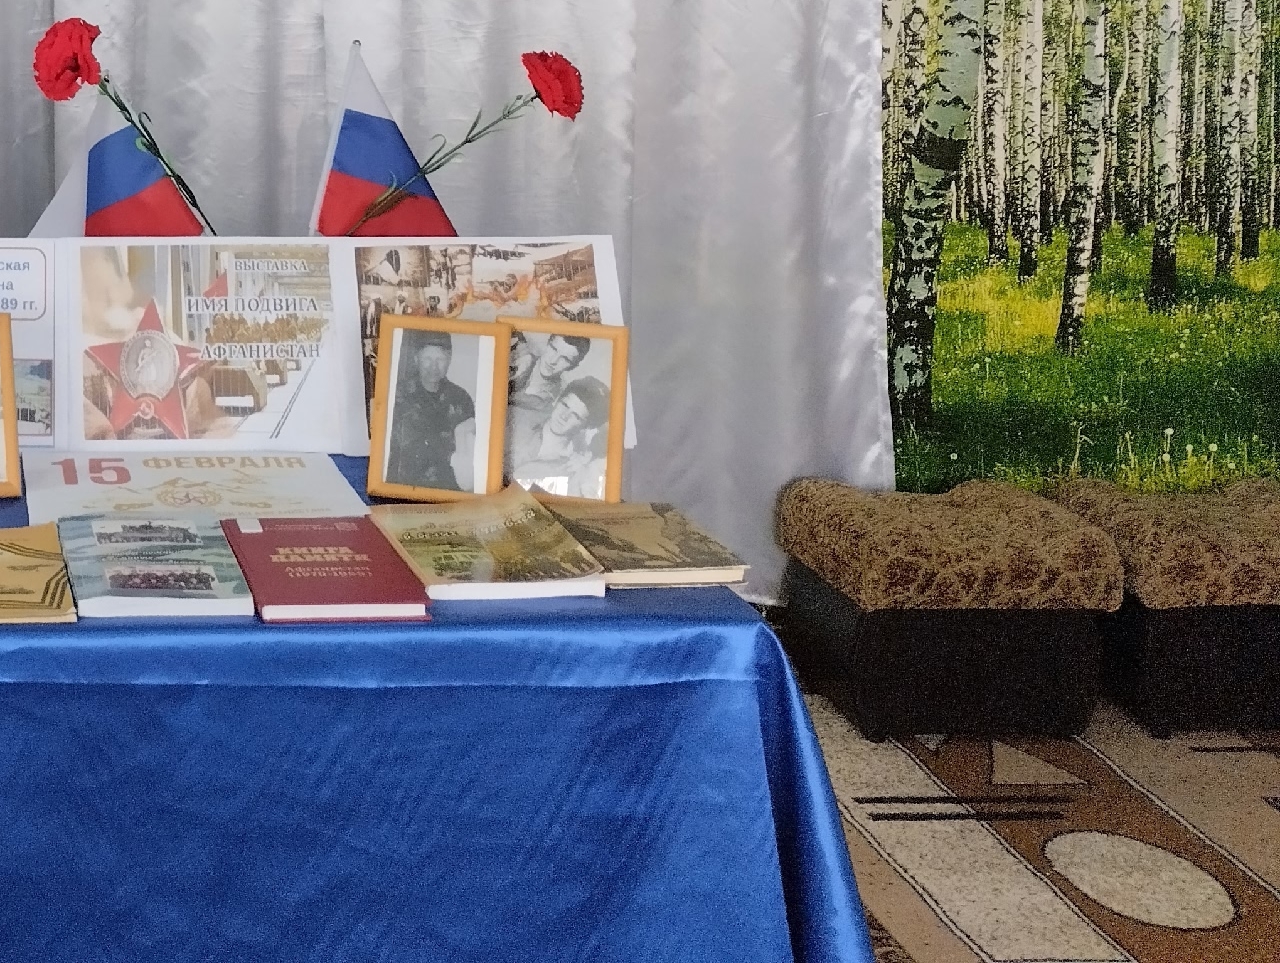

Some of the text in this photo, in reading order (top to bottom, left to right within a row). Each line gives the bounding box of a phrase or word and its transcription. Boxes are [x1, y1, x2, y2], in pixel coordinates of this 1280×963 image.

[234, 260, 308, 271] ВЫСТАВКА
[22, 300, 38, 310] гг.
[187, 298, 229, 312] ИМЯ
[234, 298, 319, 314] ПОДВИГА
[200, 343, 320, 358] АФГАНИСТАН
[51, 456, 307, 485] 15 ФЕВРАЛЯ
